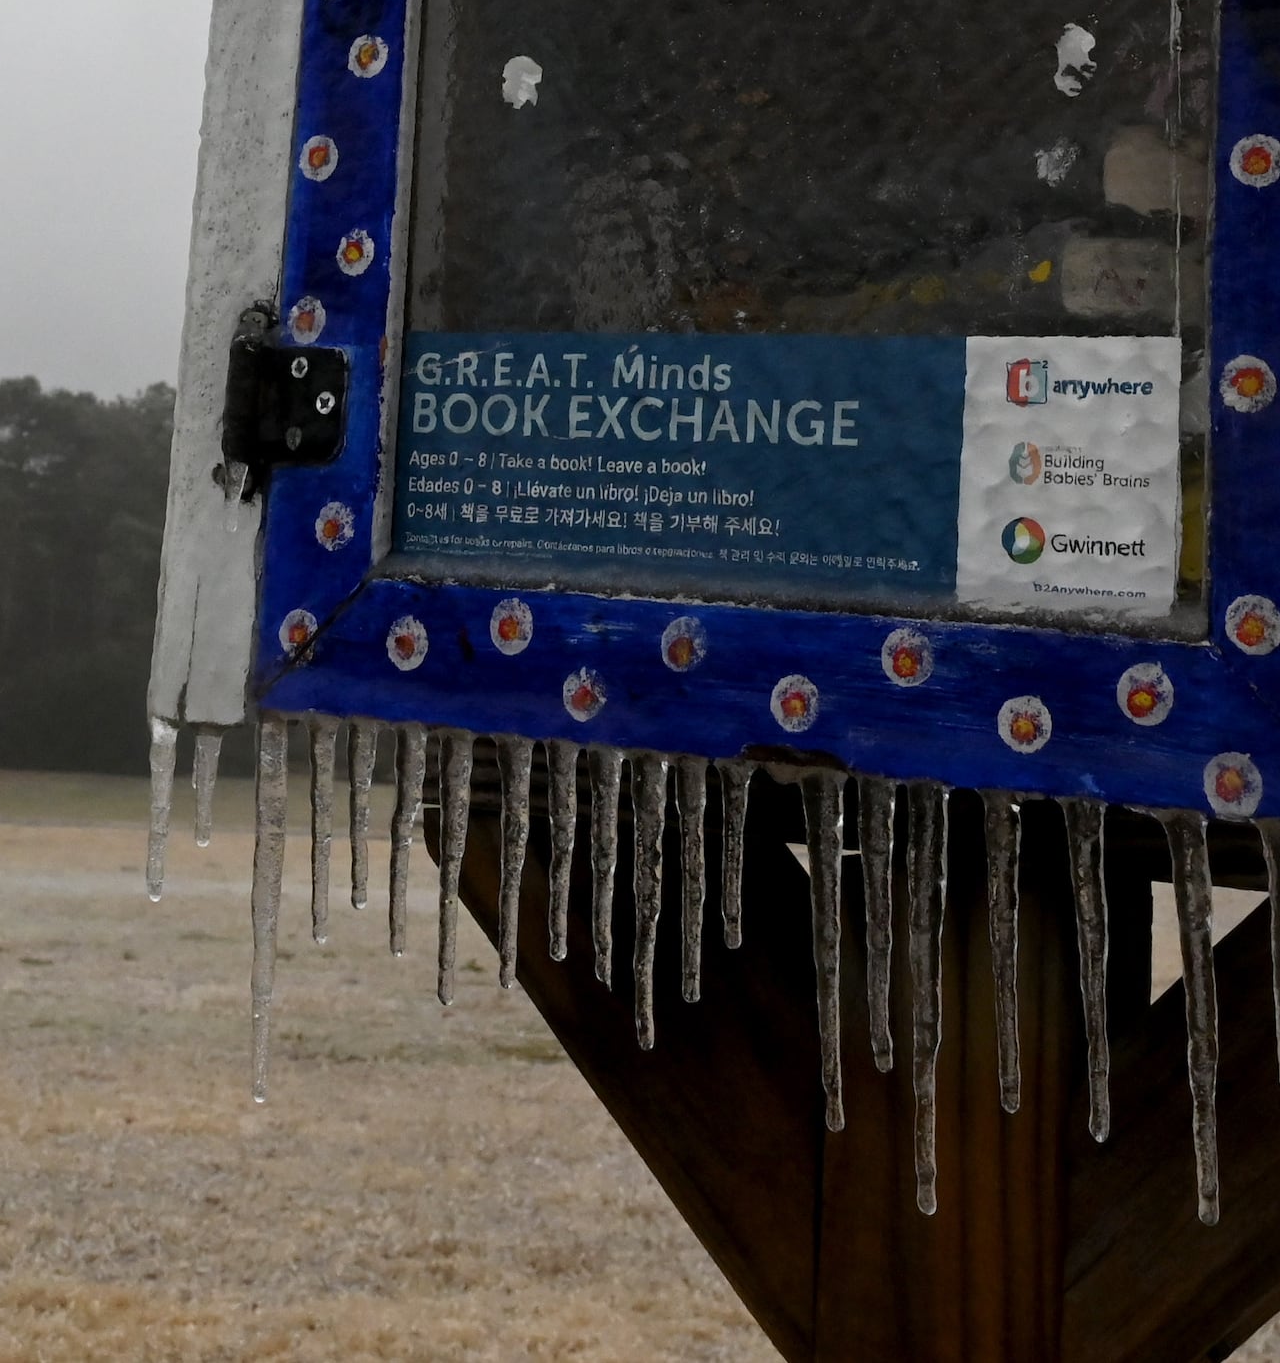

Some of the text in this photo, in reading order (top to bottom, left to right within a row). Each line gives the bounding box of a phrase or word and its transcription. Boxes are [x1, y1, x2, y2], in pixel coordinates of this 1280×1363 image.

[416, 351, 733, 392] G.R.E.A.T. Minds
[1052, 377, 1154, 400] anywhere
[412, 391, 860, 447] BOOK EXCHANGE
[408, 449, 446, 469] Ages
[448, 451, 459, 467] 0
[478, 451, 488, 468] 8
[498, 452, 534, 469] Take
[537, 457, 547, 470] a
[550, 454, 593, 472] book!
[597, 455, 643, 474] Leave
[646, 460, 657, 475] a
[661, 457, 707, 476] book!
[1044, 453, 1105, 472] Building
[408, 475, 460, 494] Edades
[463, 477, 474, 495] 0
[491, 480, 502, 496] 8
[576, 487, 595, 500] un
[599, 483, 639, 502] libro!
[644, 485, 683, 506] ¡Deja
[687, 491, 708, 504] un
[712, 488, 755, 507] libro!
[1103, 473, 1151, 488] Brains
[460, 502, 490, 524] 책을
[494, 504, 540, 525] 무료로
[544, 507, 628, 529] 가져가세요!
[633, 511, 665, 533] 책을
[670, 512, 720, 534] 기부해
[724, 516, 781, 537] 주세요!
[596, 544, 615, 555] para
[1050, 533, 1146, 557] Gwinnett
